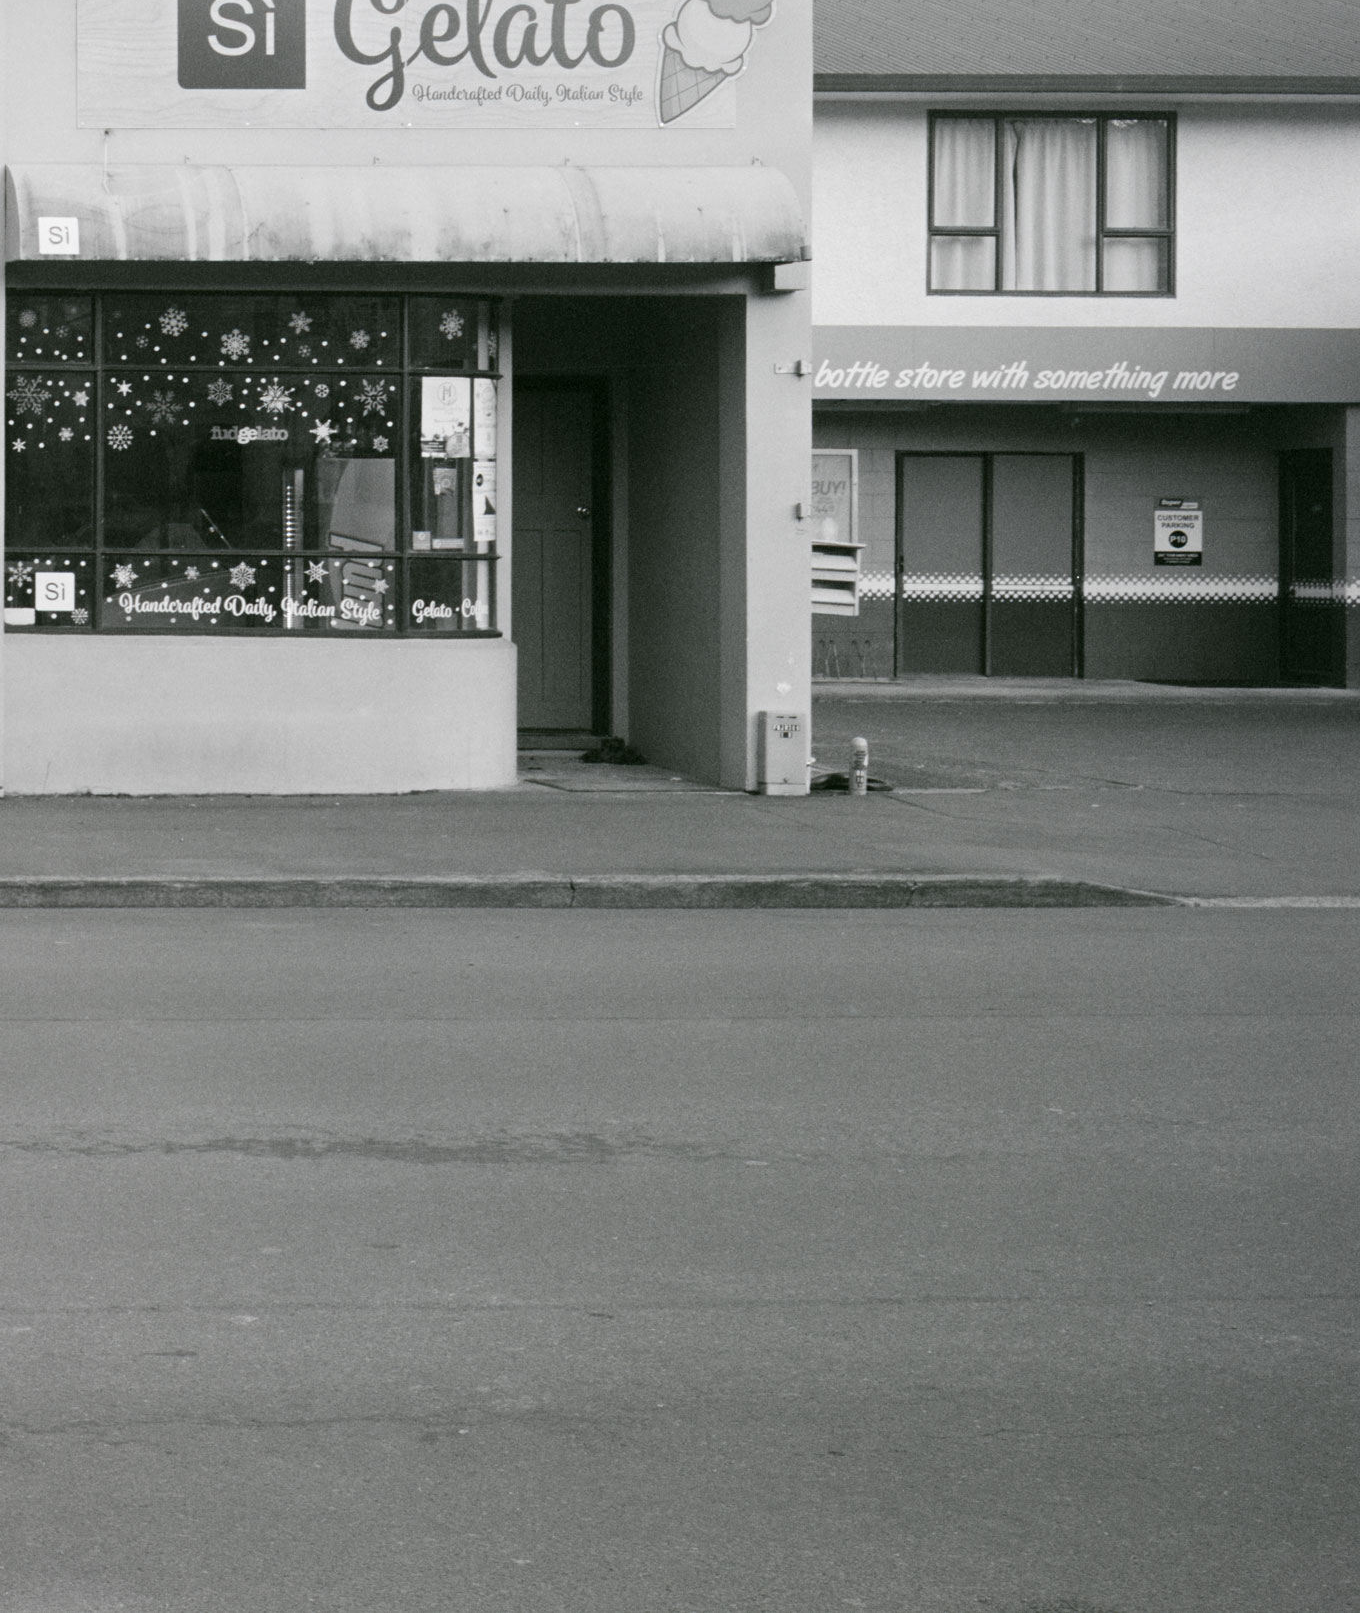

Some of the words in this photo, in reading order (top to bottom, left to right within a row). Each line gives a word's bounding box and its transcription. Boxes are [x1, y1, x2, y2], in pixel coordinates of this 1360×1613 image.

[411, 83, 502, 106] Handcrafted
[505, 83, 553, 106] Daily,
[555, 83, 604, 101] Italian
[608, 83, 644, 106] Style
[814, 359, 890, 388] bottle
[894, 360, 965, 389] store
[971, 359, 1030, 389] with
[1033, 360, 1169, 397] something
[1172, 369, 1240, 390] more
[210, 425, 289, 444] fudgelato
[1170, 535, 1187, 544] P10
[44, 582, 66, 601] Sì
[118, 592, 222, 620] Handcrafted
[223, 594, 277, 622] Daily,
[280, 596, 335, 618] Italian
[340, 599, 380, 626] Style
[412, 598, 453, 624] Gelato
